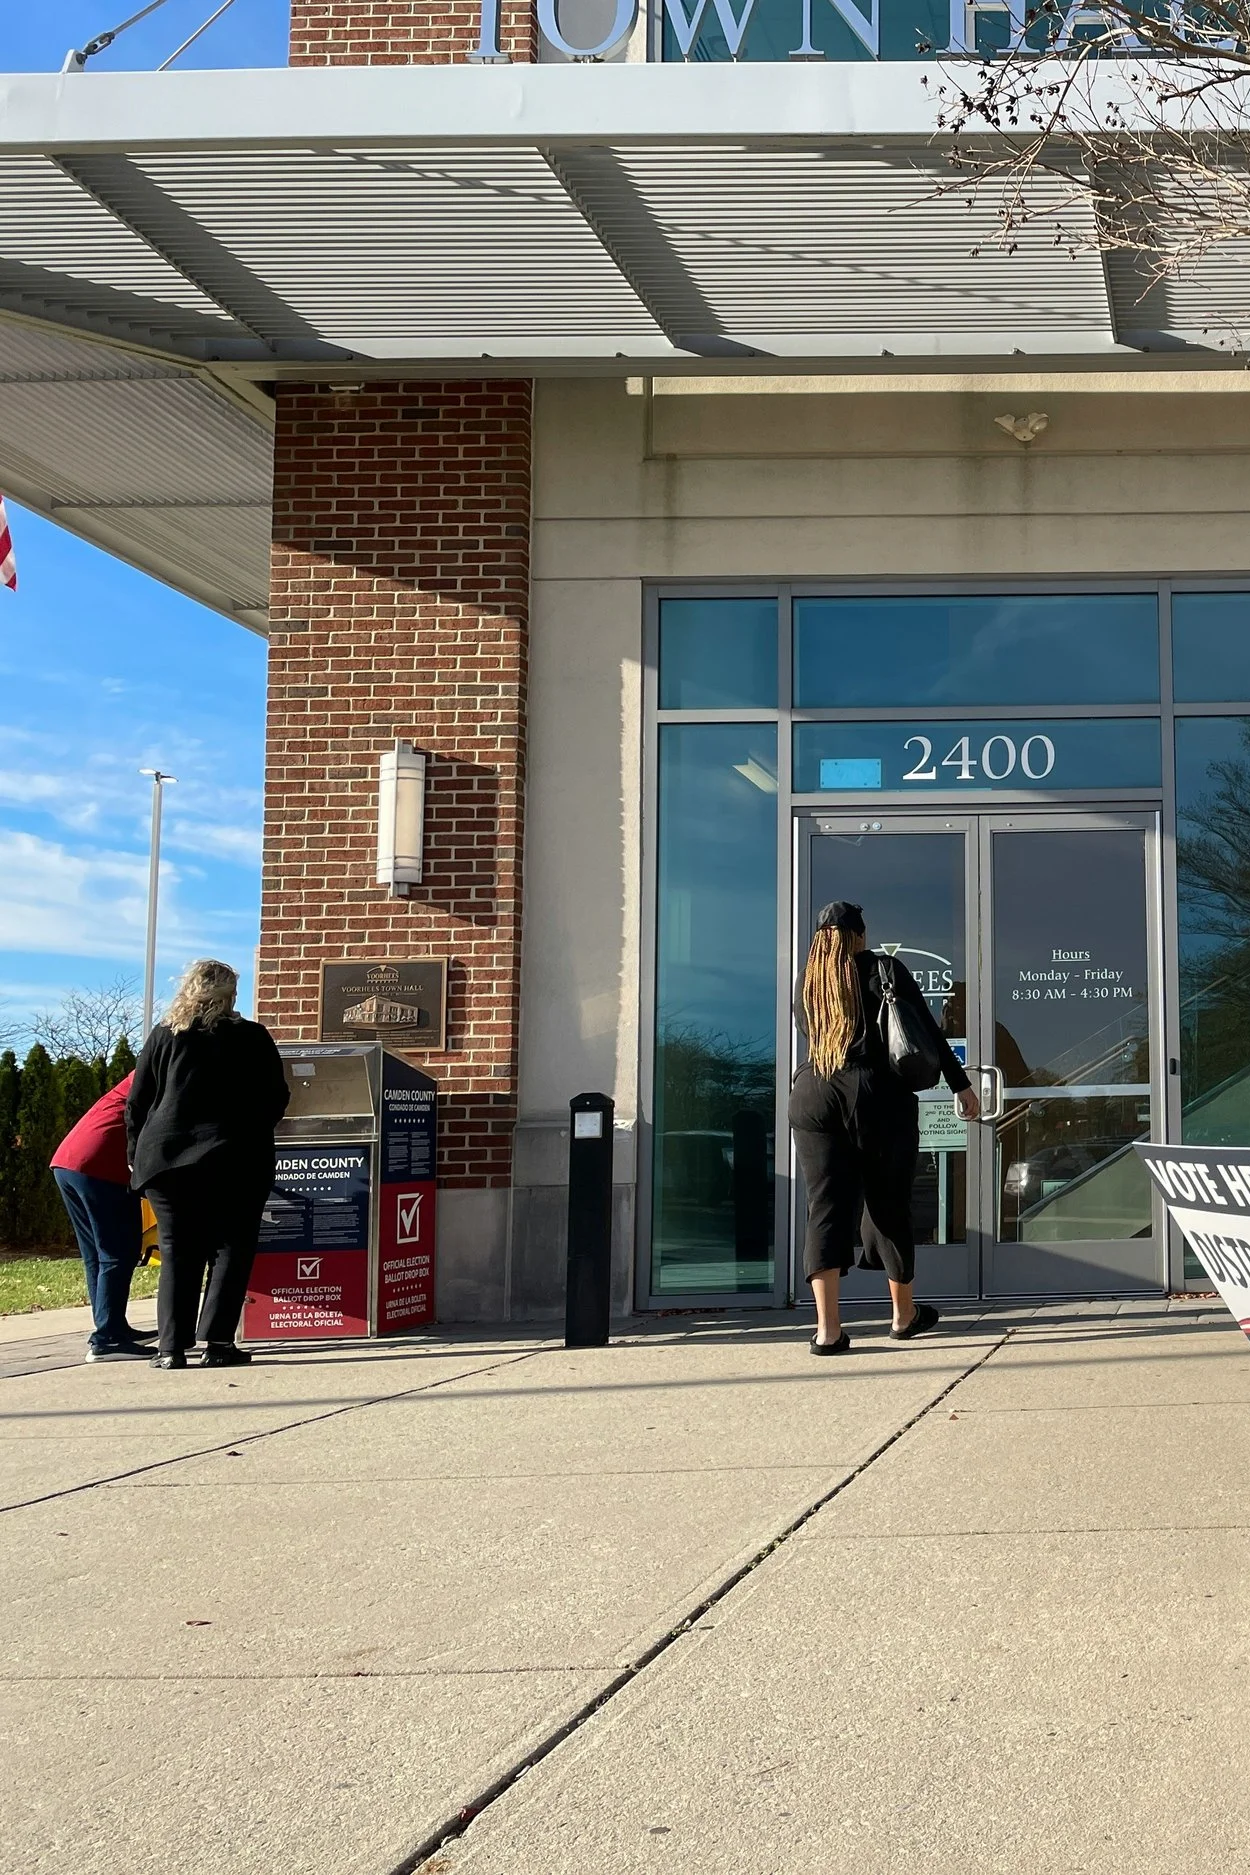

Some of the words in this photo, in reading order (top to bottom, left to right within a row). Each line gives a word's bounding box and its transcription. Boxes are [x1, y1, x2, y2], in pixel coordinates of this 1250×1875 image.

[902, 735, 1056, 780] 2400
[1051, 949, 1091, 961] Hours
[366, 972, 400, 980] VOORHEES
[1019, 969, 1070, 984] Monday
[1084, 968, 1123, 982] Friday
[403, 984, 424, 992] HALL
[1012, 988, 1041, 1001] 8:30
[1043, 988, 1066, 1000] AM
[1080, 986, 1109, 999] 4:30
[1113, 986, 1133, 998] PM
[384, 1089, 410, 1101] CAMDEN
[411, 1090, 436, 1102] COUNTY
[388, 1103, 409, 1112] CONDADO
[408, 1104, 414, 1112] DE
[413, 1104, 431, 1112] CAMDEN
[275, 1158, 308, 1170] DEN
[311, 1157, 364, 1169] COUNTY
[275, 1173, 306, 1181] NDADO
[306, 1172, 317, 1180] DE
[317, 1171, 351, 1179] CAMDEN
[1145, 1158, 1228, 1206] VOTE
[383, 1259, 406, 1271] OFFICIAL
[406, 1255, 430, 1268] ELECTION
[385, 1271, 404, 1284] BALLOT
[404, 1269, 419, 1281] DROP
[419, 1267, 430, 1278] BOX
[271, 1287, 305, 1295] OFFICIAL
[305, 1285, 342, 1294] ELECTION
[273, 1296, 302, 1304] BALLOT
[386, 1299, 399, 1309] URNA
[411, 1293, 427, 1304] BOLETA
[314, 1310, 343, 1318] BOLETA
[386, 1308, 411, 1320] ELECTORAL
[411, 1304, 427, 1314] OFICIAL
[270, 1320, 313, 1329] ELECTORAL
[314, 1319, 344, 1327] OFICIAL
